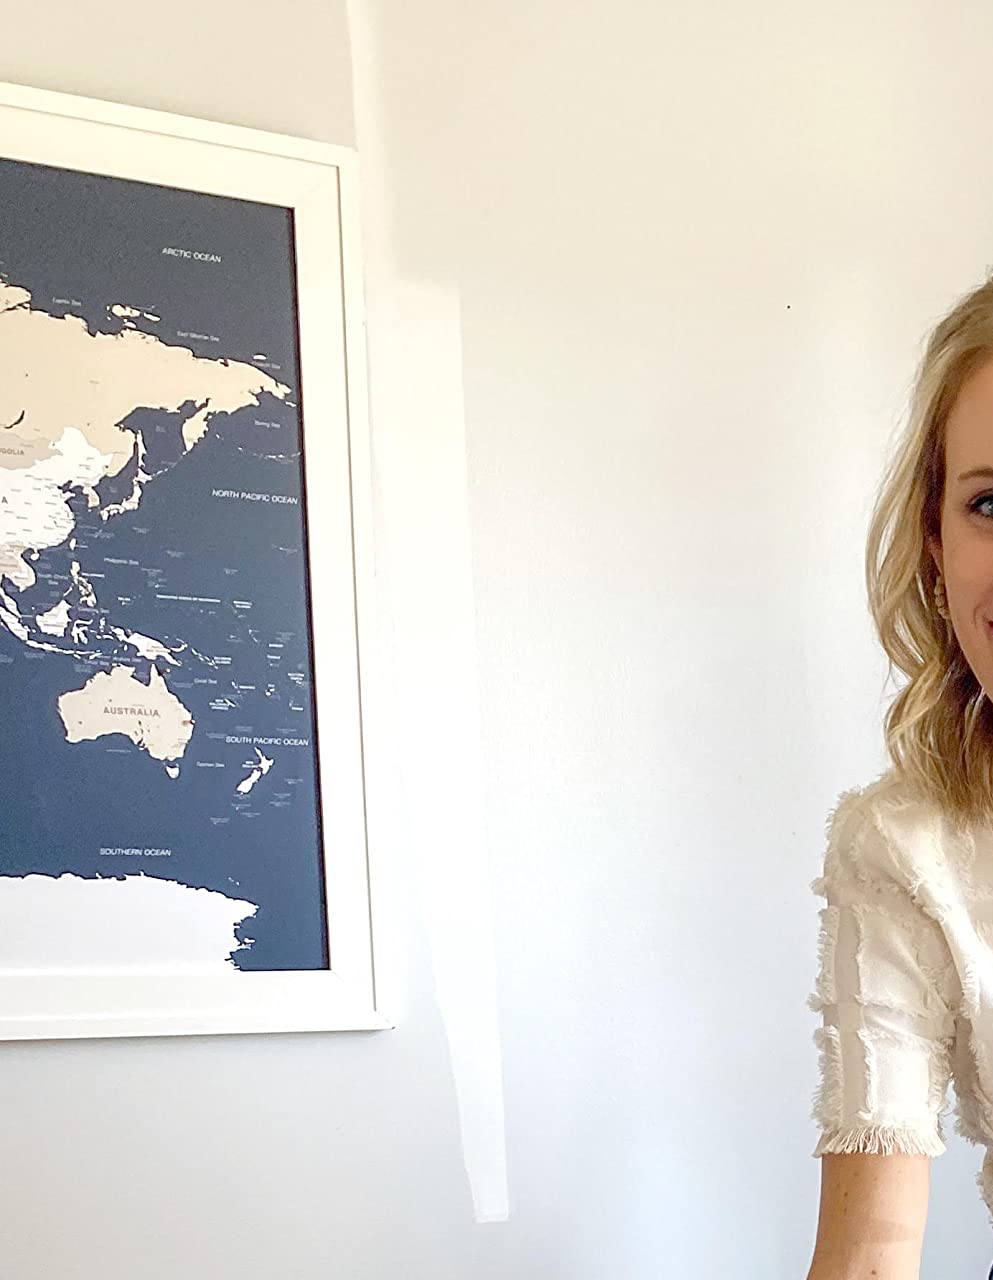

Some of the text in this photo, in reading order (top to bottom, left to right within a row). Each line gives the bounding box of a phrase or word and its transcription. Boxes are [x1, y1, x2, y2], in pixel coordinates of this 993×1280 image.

[162, 247, 221, 263] ARCTIC OCEAN
[212, 489, 298, 504] NORTH PACIFIC OCEAN
[103, 706, 161, 719] AUSTRALIA
[225, 736, 309, 746] SOUTH PACIFIC OCEAN
[100, 847, 172, 857] SOUTHERN OCEAN
